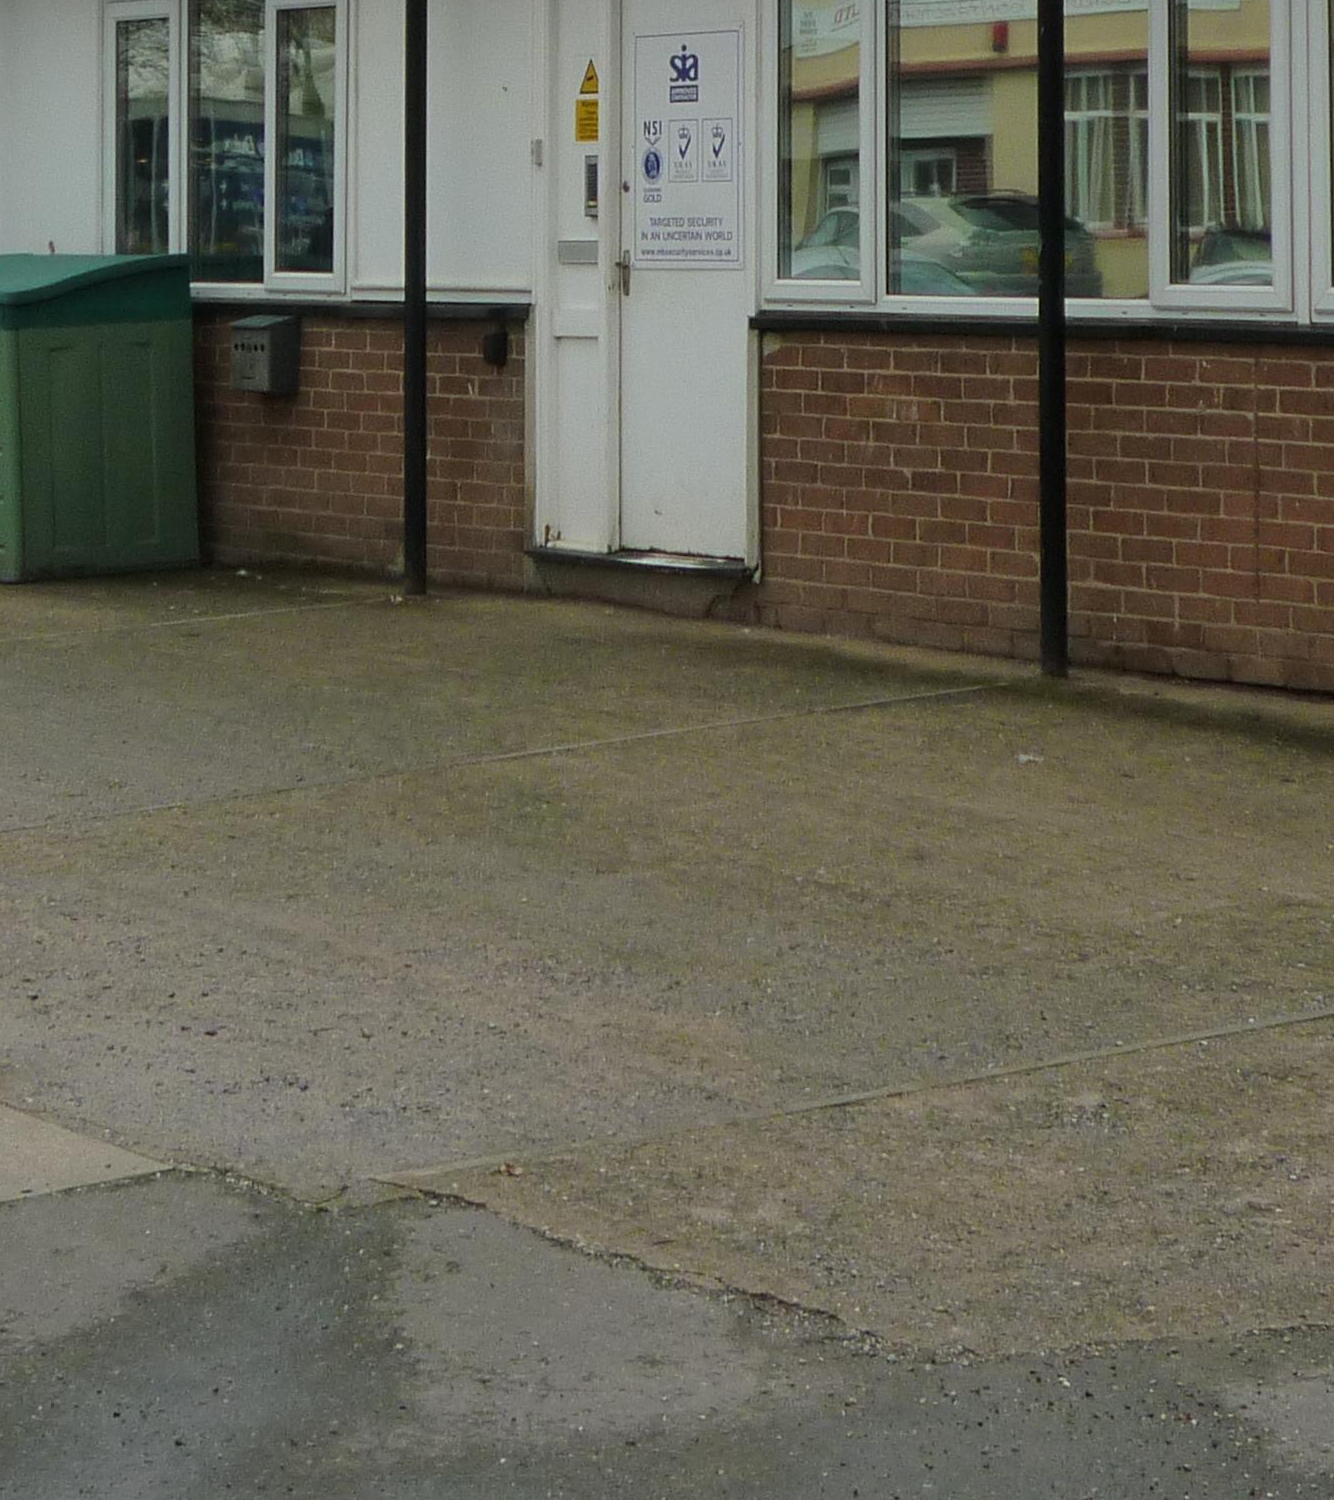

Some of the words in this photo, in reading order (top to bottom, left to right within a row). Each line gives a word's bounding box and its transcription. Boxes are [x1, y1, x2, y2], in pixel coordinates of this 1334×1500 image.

[643, 120, 662, 136] NSI
[643, 194, 662, 203] GOLD
[650, 217, 684, 227] TARGETED
[687, 217, 723, 227] SECURITY
[650, 231, 660, 240] AN
[662, 231, 703, 240] UNCERTAIN
[704, 231, 733, 240] WORLD
